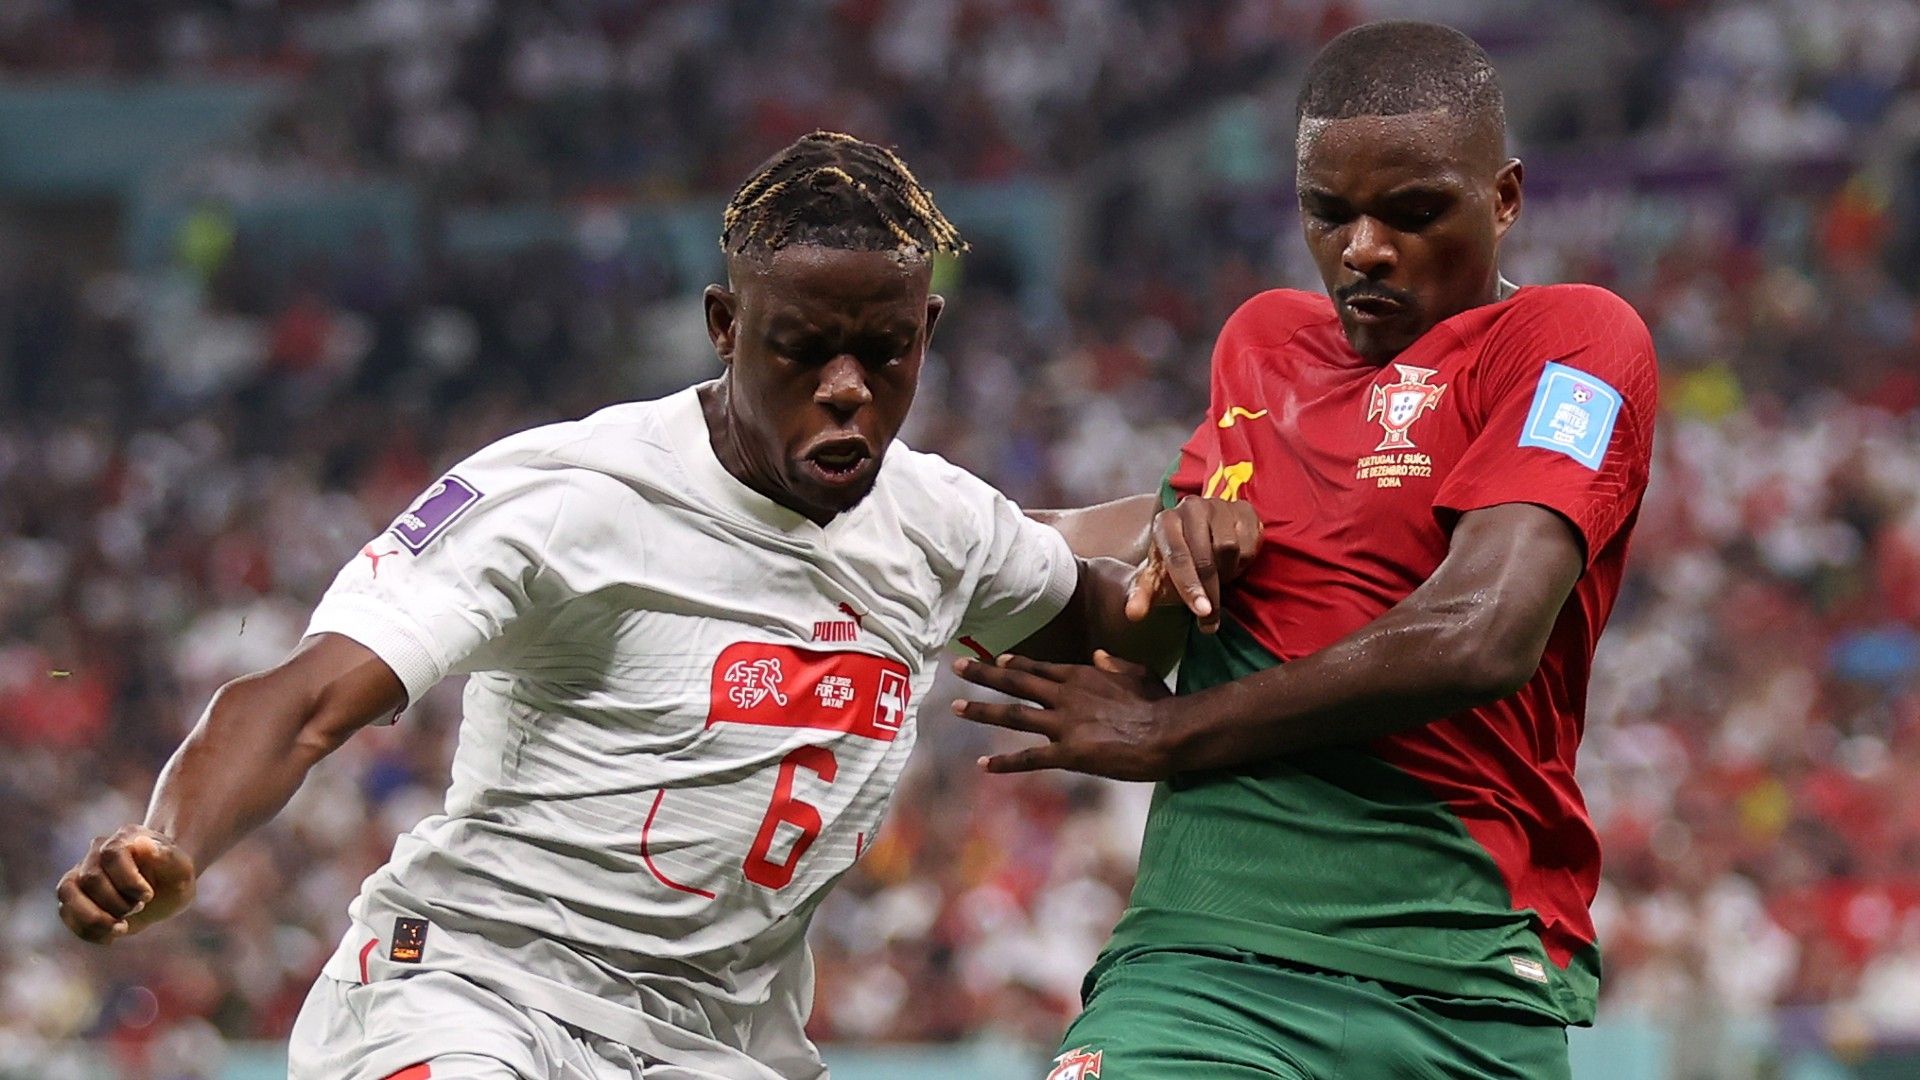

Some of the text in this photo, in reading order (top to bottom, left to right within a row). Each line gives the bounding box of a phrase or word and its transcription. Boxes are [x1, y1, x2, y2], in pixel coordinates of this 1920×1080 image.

[1357, 454, 1395, 468] PORTUGAL
[1369, 465, 1408, 478] DEZEMBRO
[1408, 466, 1431, 478] 2022
[1377, 476, 1402, 488] DOHA
[811, 621, 857, 641] PUMA
[742, 743, 839, 891] 6
